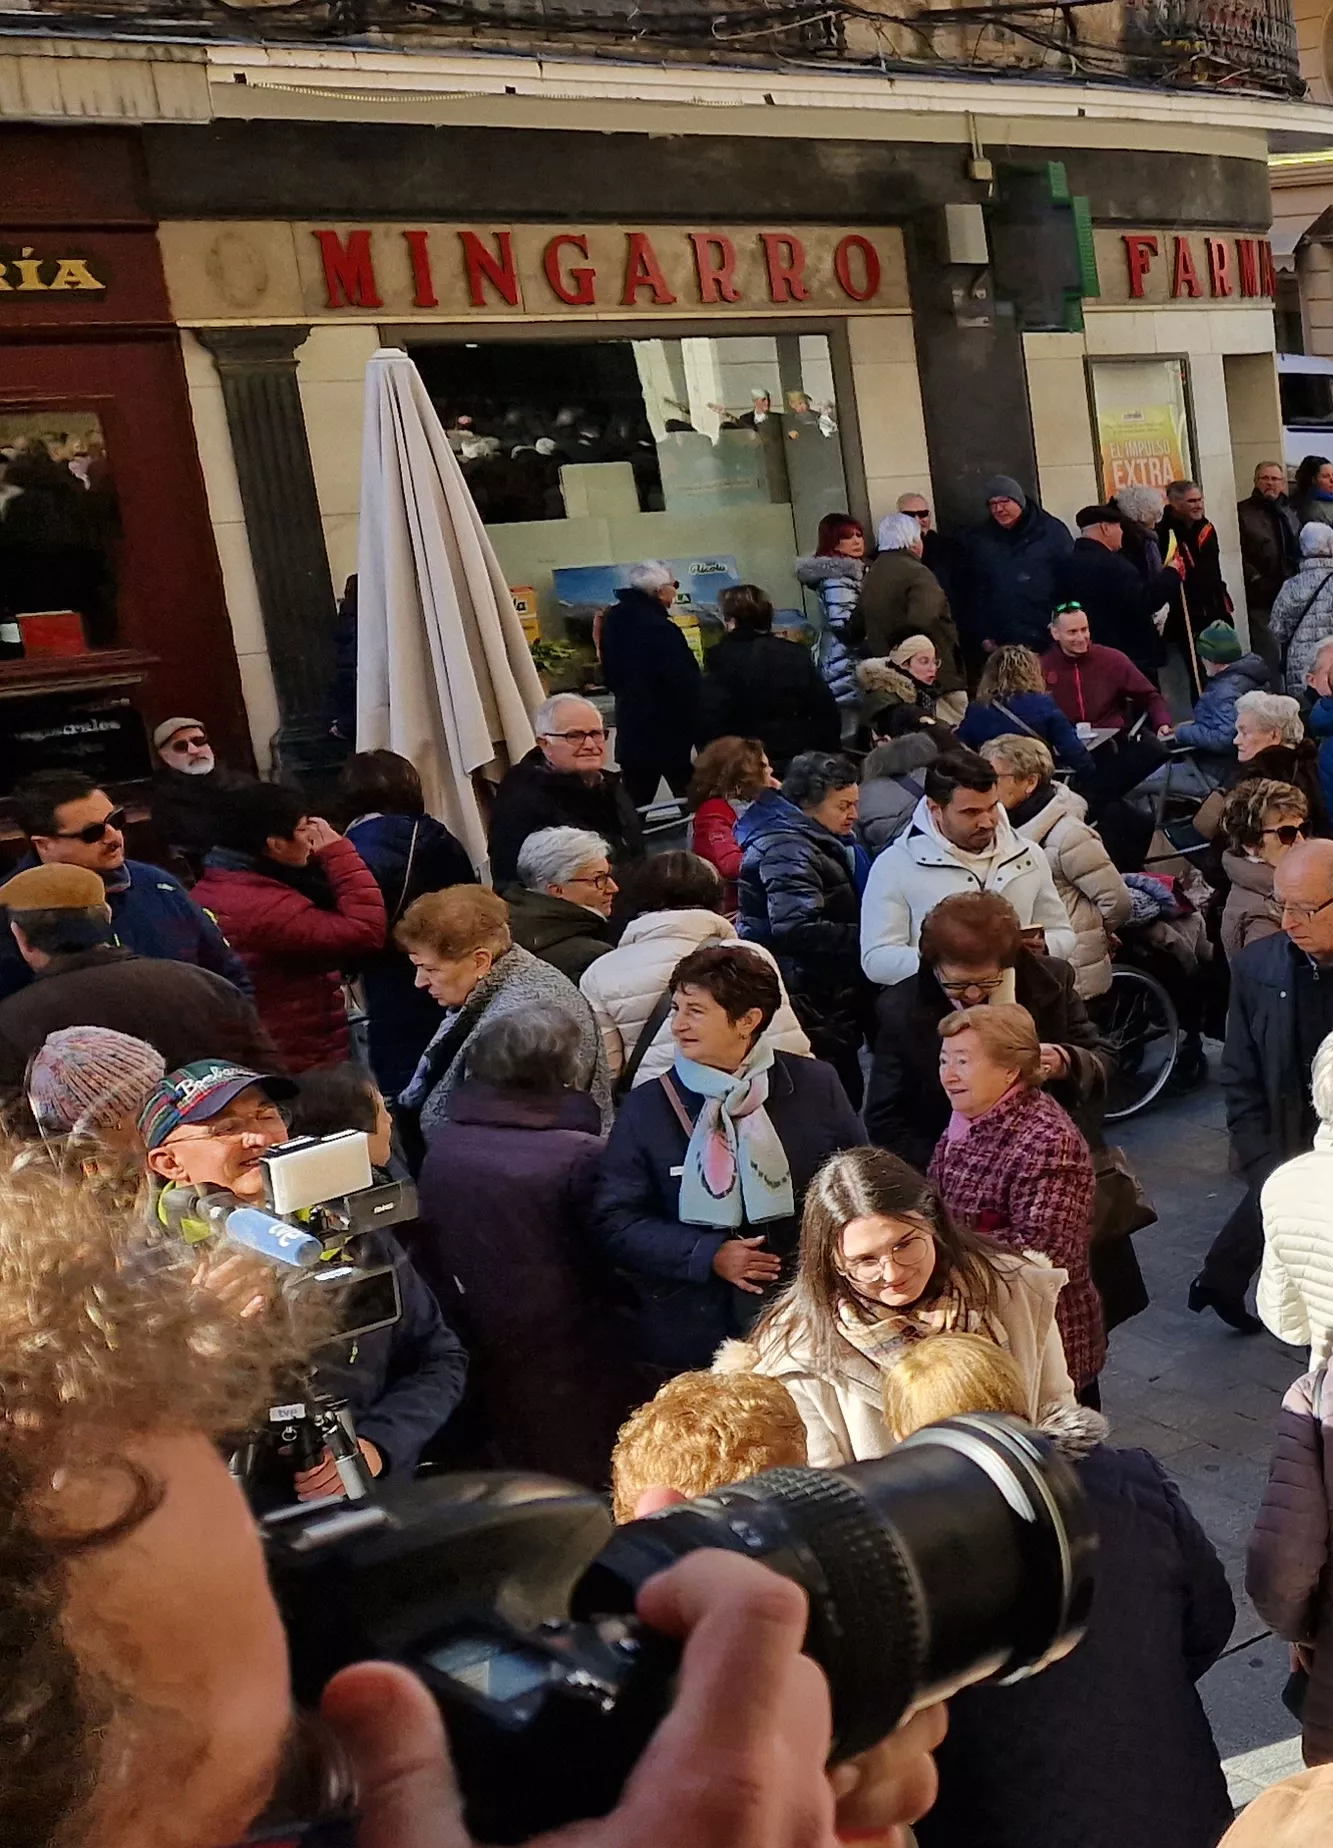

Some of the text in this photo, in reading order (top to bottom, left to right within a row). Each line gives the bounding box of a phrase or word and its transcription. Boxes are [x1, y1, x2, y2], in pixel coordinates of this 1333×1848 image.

[311, 228, 882, 308] MINGARRO
[1110, 439, 1171, 459] EL IMPULSO
[1111, 456, 1176, 489] EXTRA
